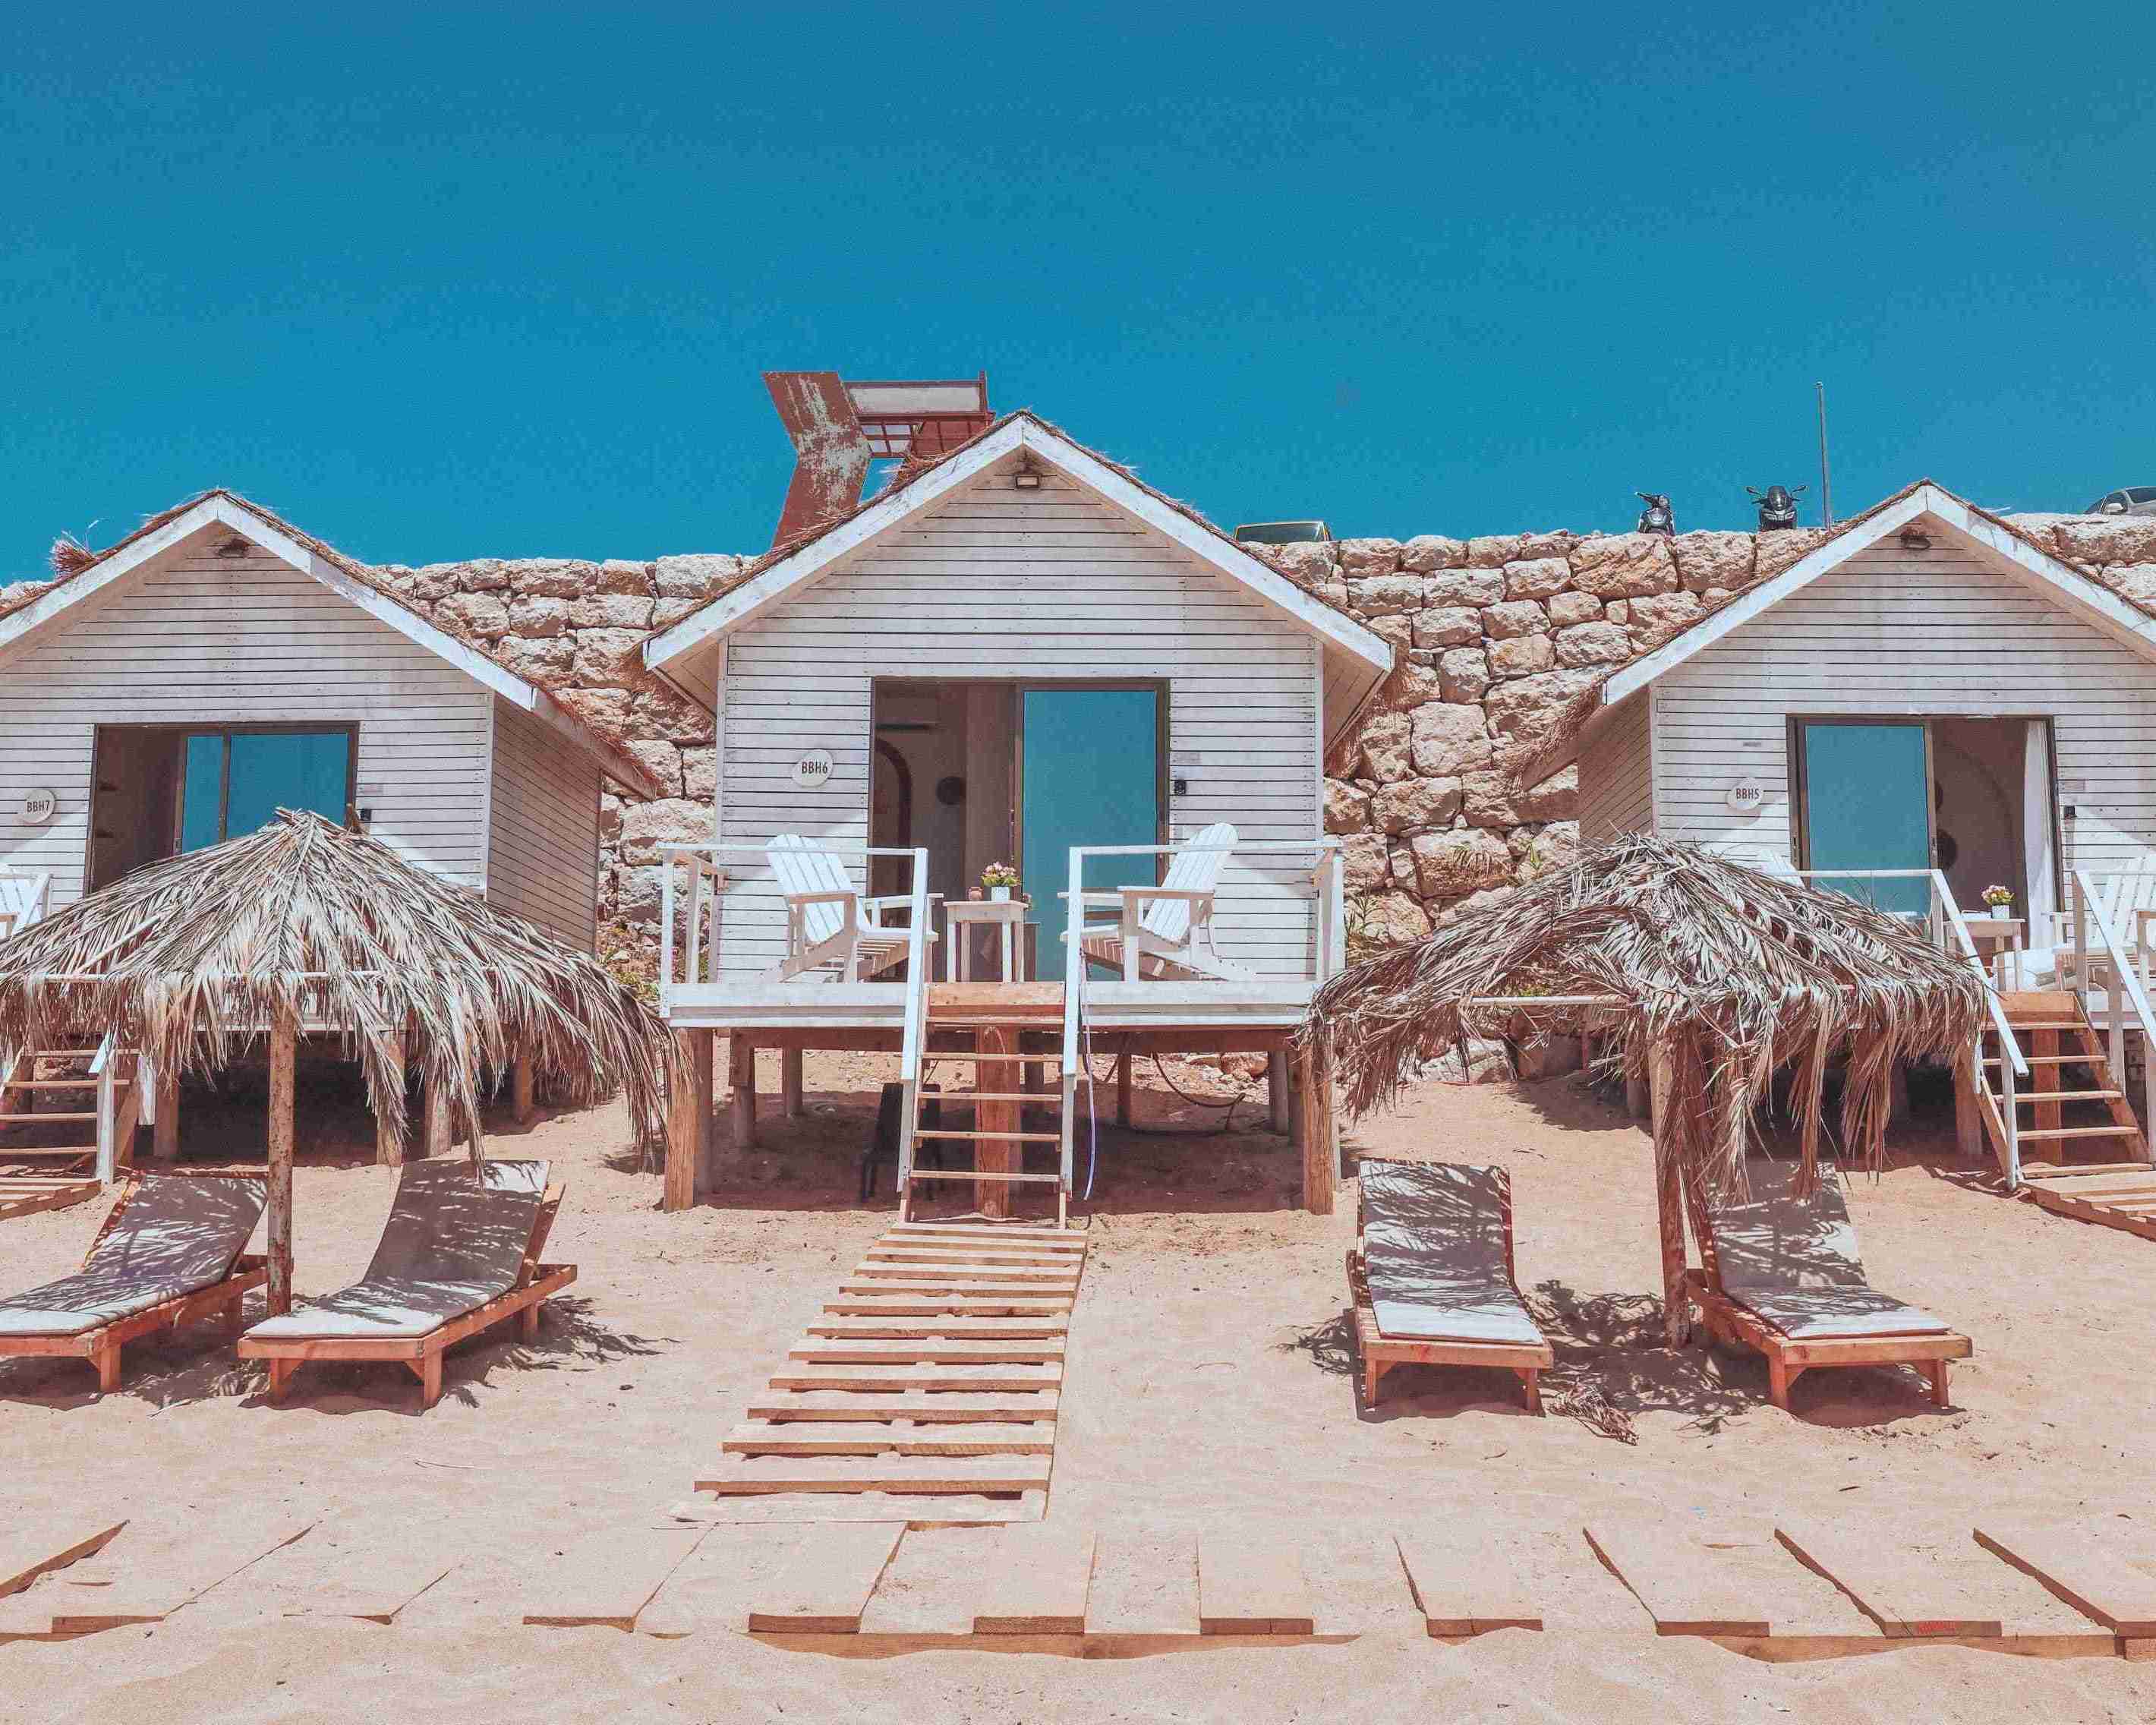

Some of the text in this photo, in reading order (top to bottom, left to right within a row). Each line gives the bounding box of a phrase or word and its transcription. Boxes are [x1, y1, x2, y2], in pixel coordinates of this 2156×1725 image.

[801, 761, 827, 774] BBH6
[1736, 787, 1760, 799] BBH5
[27, 799, 50, 812] BBH7
